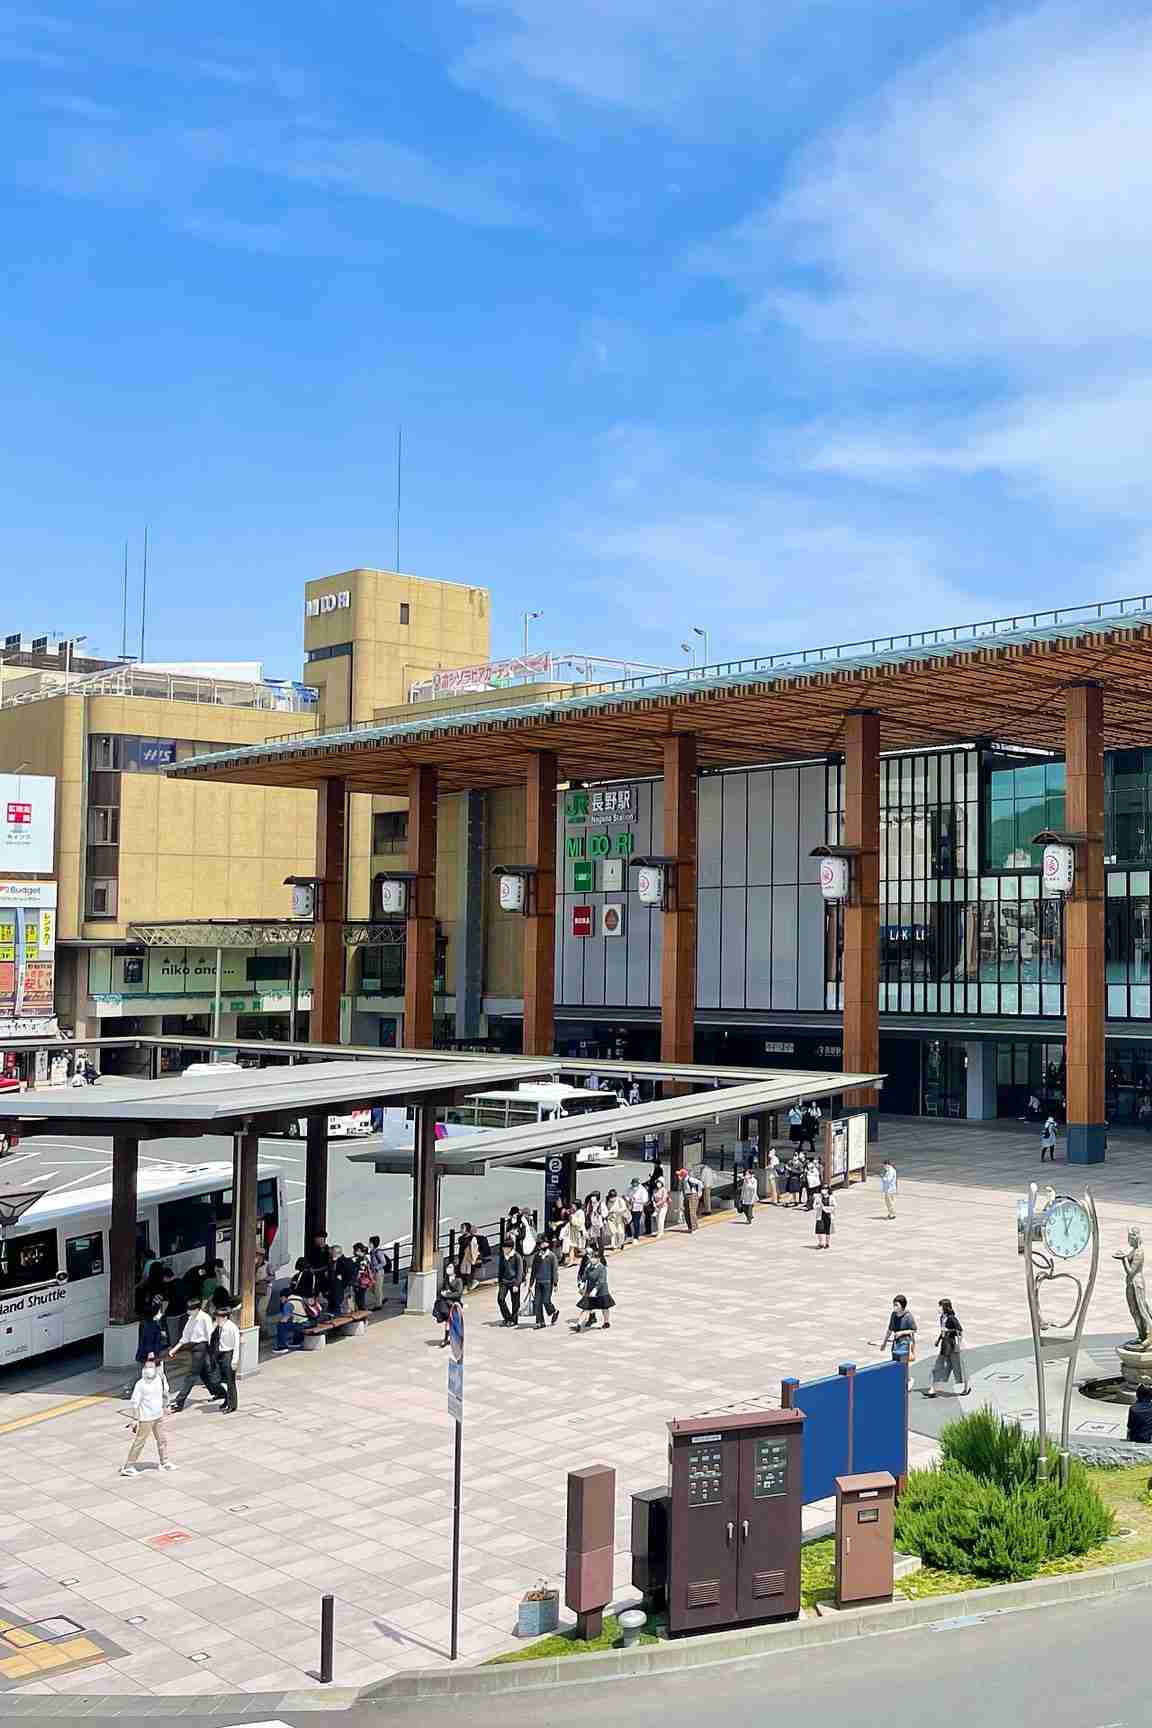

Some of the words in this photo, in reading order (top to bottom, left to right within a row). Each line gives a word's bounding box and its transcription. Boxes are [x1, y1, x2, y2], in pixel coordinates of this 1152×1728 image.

[592, 791, 630, 811] 長野駅
[567, 833, 632, 857] MIDORI
[10, 886, 41, 895] Budget
[161, 965, 190, 975] niko
[551, 1161, 560, 1170] 2
[28, 1288, 66, 1308] Shuttle
